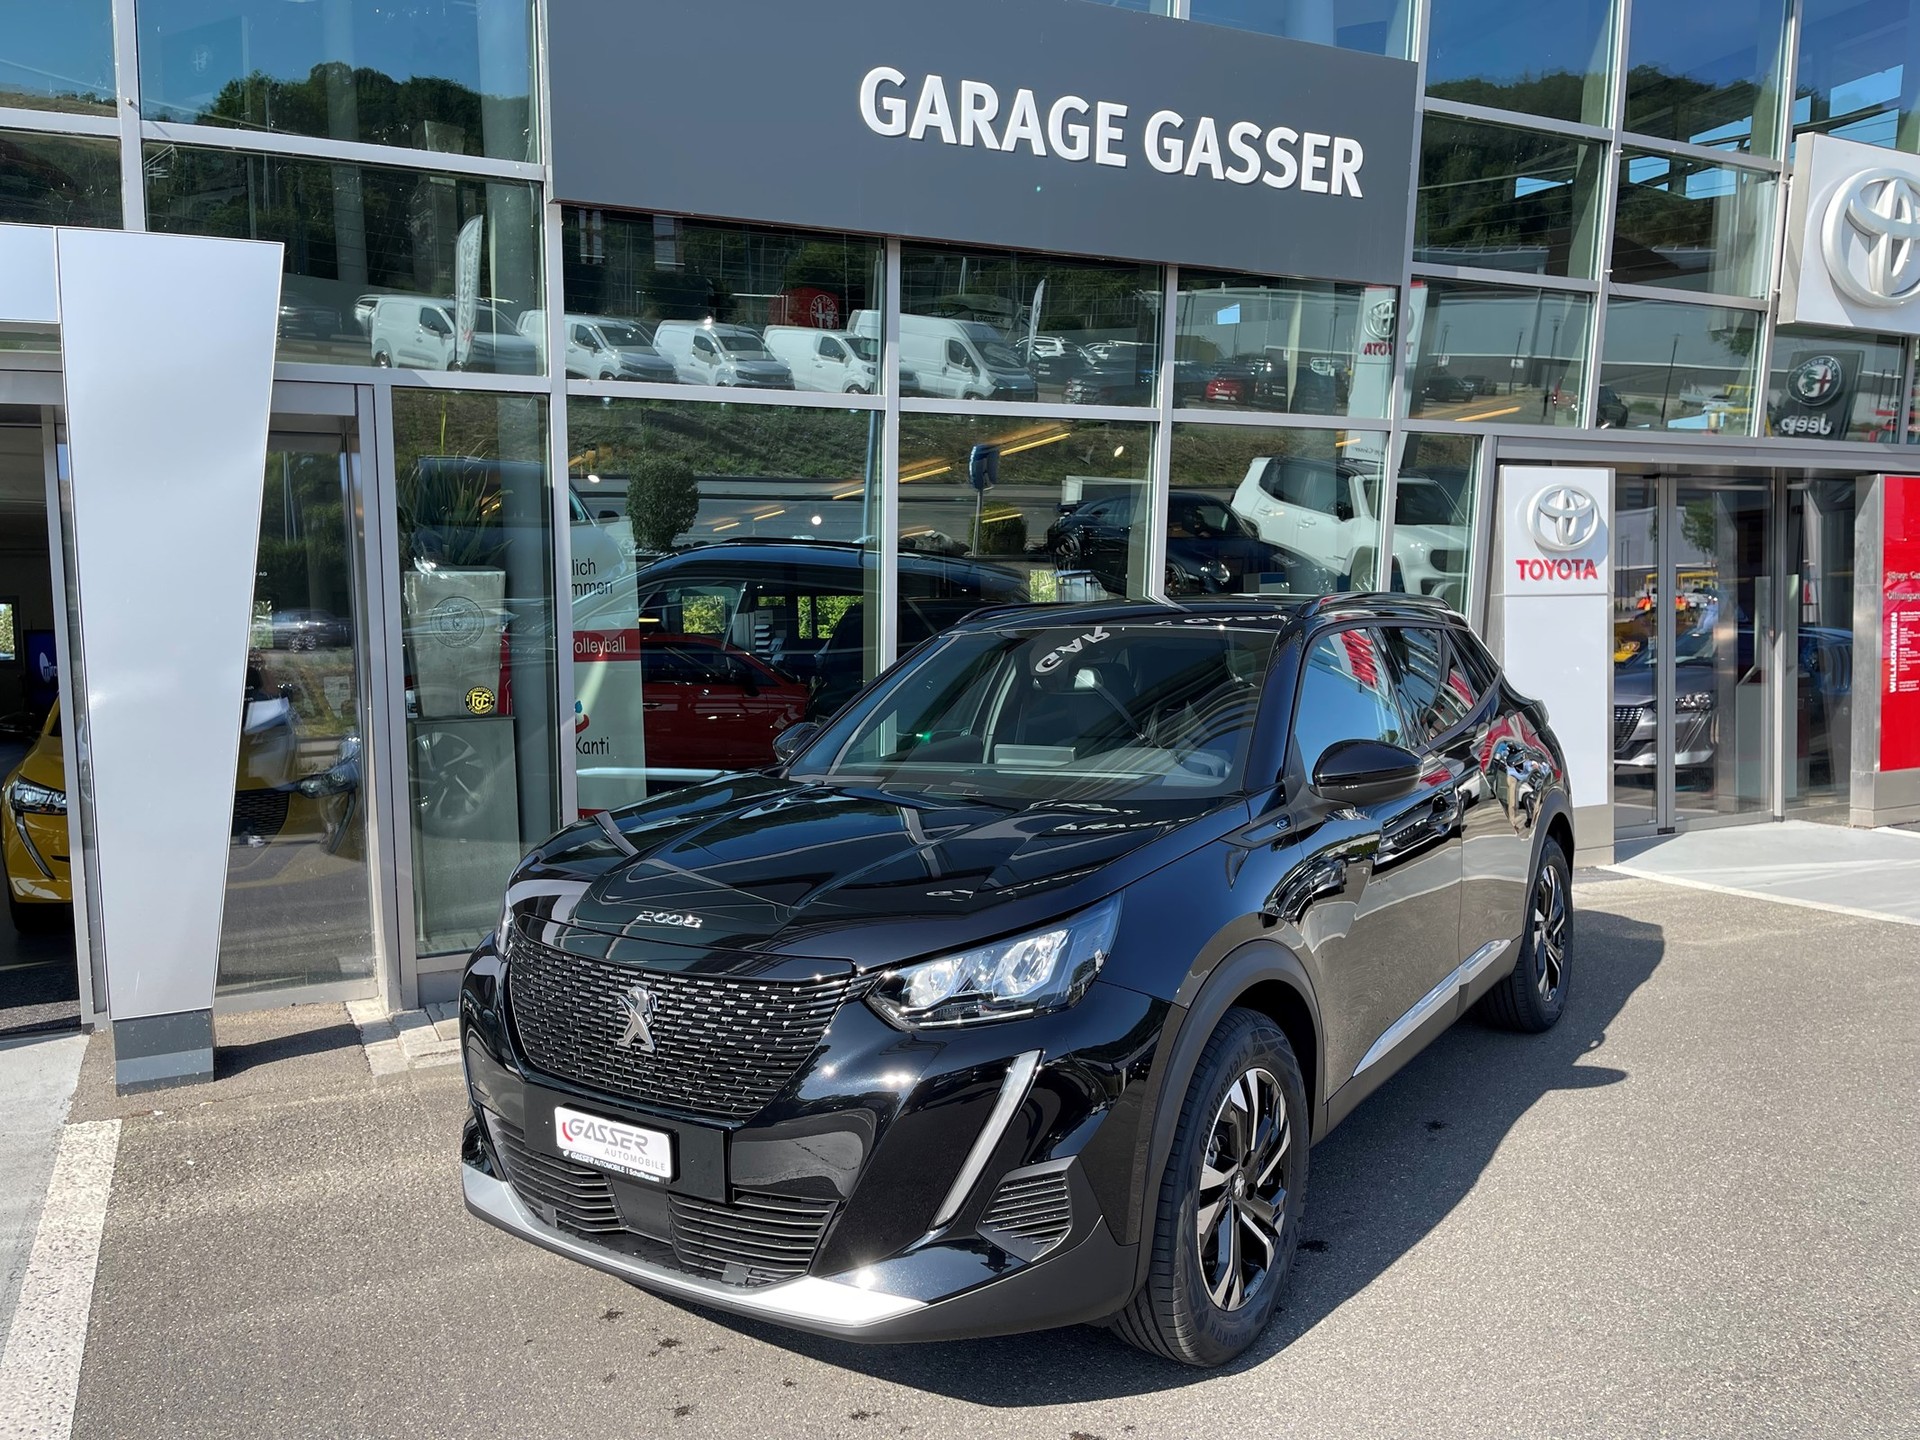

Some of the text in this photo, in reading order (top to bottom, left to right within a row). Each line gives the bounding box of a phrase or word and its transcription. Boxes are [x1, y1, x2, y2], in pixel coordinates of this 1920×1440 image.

[859, 67, 1365, 198] GARAGE GASSER
[1515, 558, 1599, 581] TOYOTA
[573, 636, 626, 657] olleyball
[1889, 612, 1898, 694] WILLKOMMEN
[636, 910, 704, 929] 2008
[568, 1118, 648, 1156] GASSER
[570, 1151, 594, 1165] GASSER
[594, 1159, 625, 1174] AUTOMOBILE
[604, 1147, 666, 1172] AUTOMOBILE
